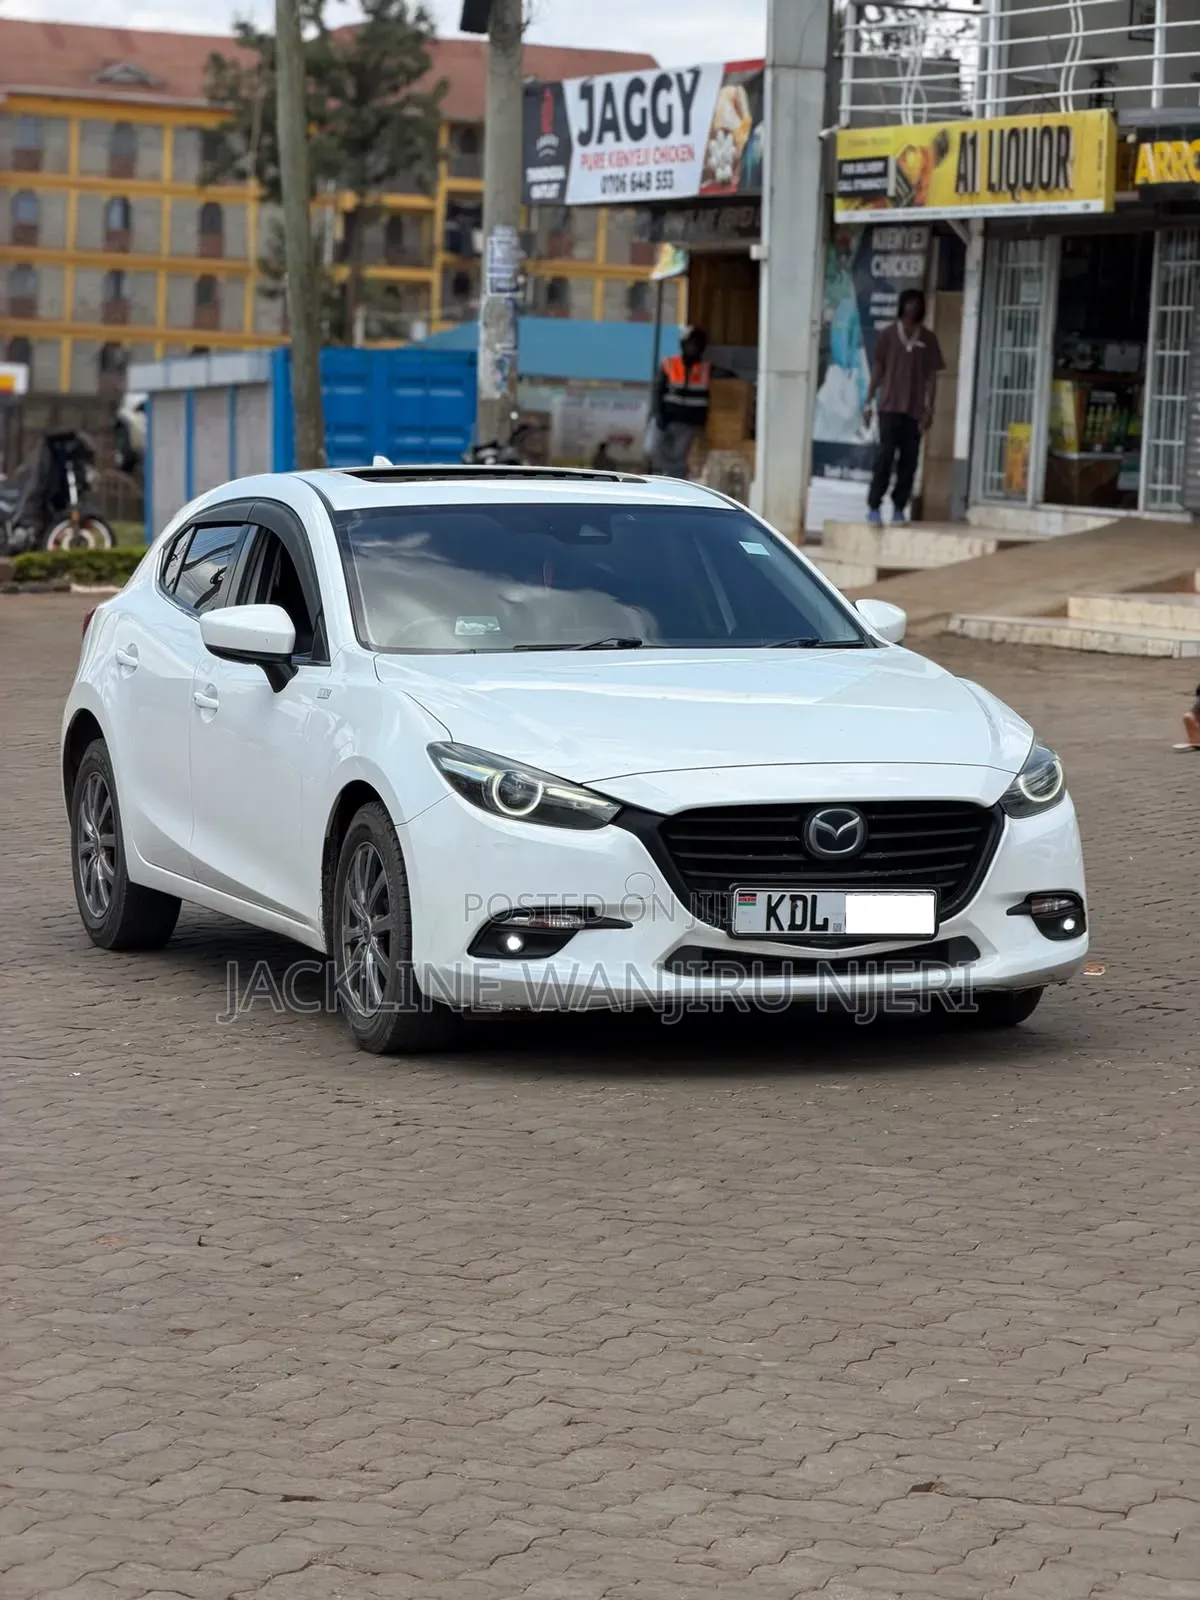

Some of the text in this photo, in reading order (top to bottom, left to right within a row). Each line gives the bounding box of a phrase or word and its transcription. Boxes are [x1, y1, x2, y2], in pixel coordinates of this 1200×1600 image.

[577, 66, 701, 147] JAGGY
[987, 125, 1074, 202] LIQUOR
[766, 893, 829, 932] KDL
